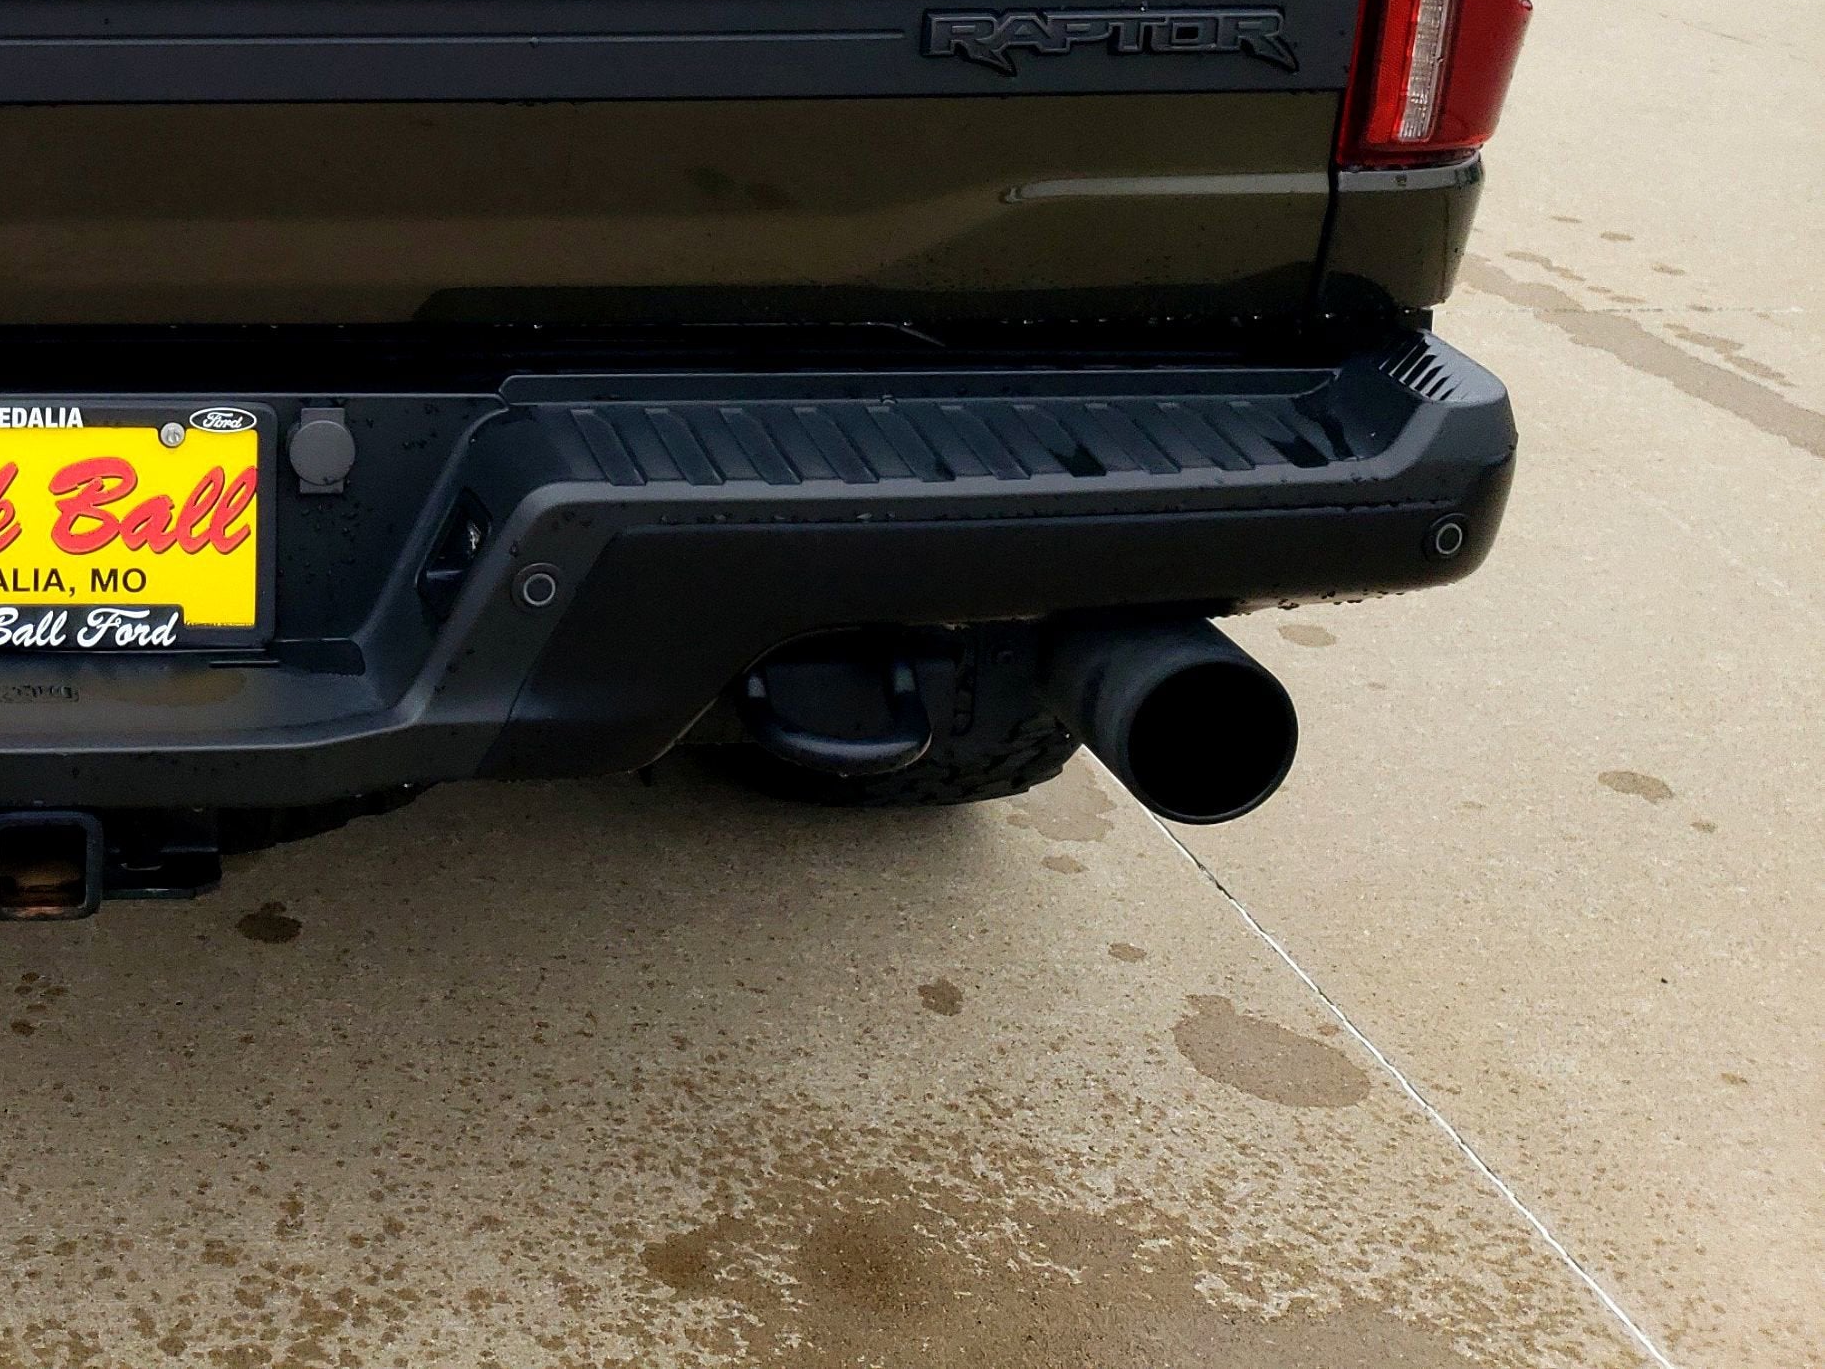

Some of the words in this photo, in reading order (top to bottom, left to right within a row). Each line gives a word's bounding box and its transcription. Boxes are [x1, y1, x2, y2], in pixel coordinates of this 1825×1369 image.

[924, 8, 1296, 75] RAPTOR
[202, 411, 243, 429] Ford
[48, 456, 257, 555] Ball
[90, 568, 147, 592] MO
[76, 608, 177, 648] Ford
